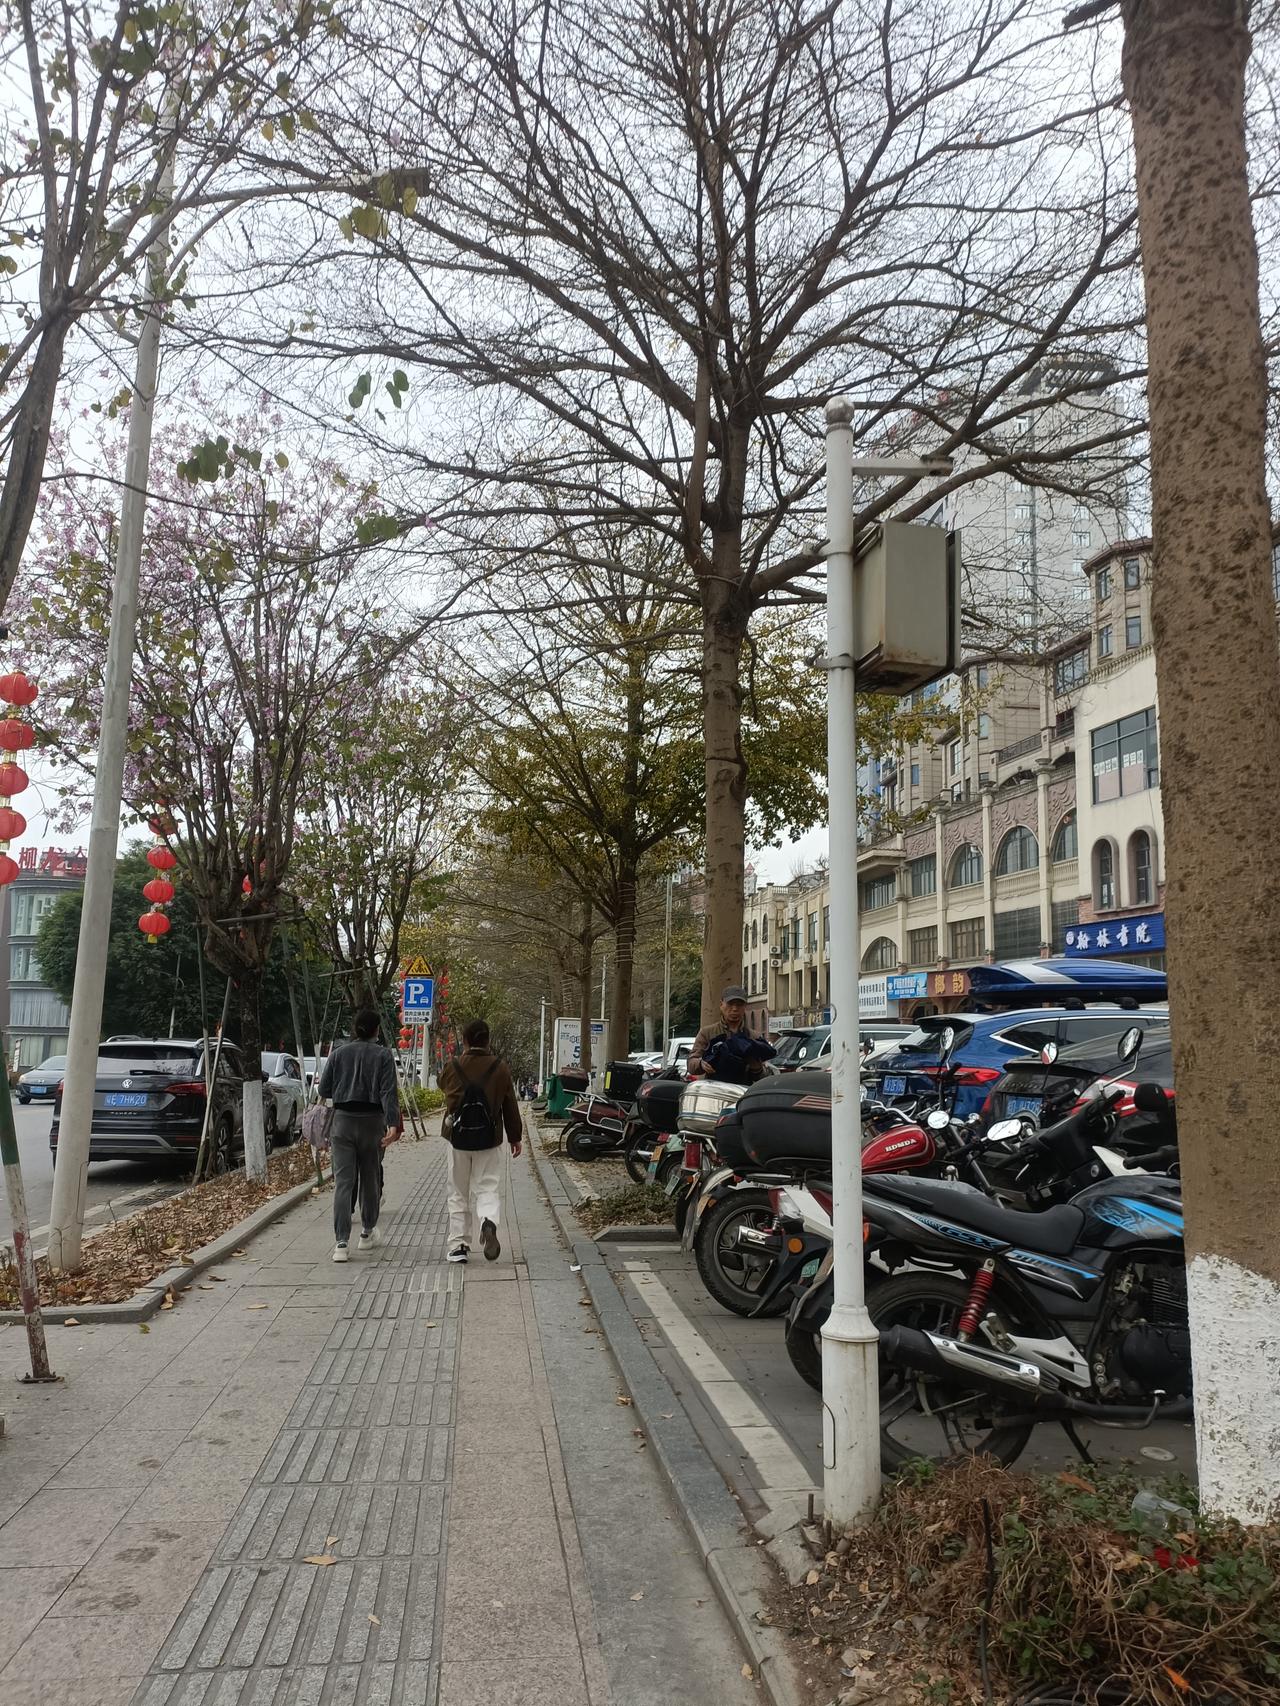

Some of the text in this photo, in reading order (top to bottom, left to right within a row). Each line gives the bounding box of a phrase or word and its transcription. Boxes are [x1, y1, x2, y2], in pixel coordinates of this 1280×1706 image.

[407, 983, 424, 1004] P
[885, 1139, 917, 1152] HONDA
[938, 1226, 994, 1249] GSX
